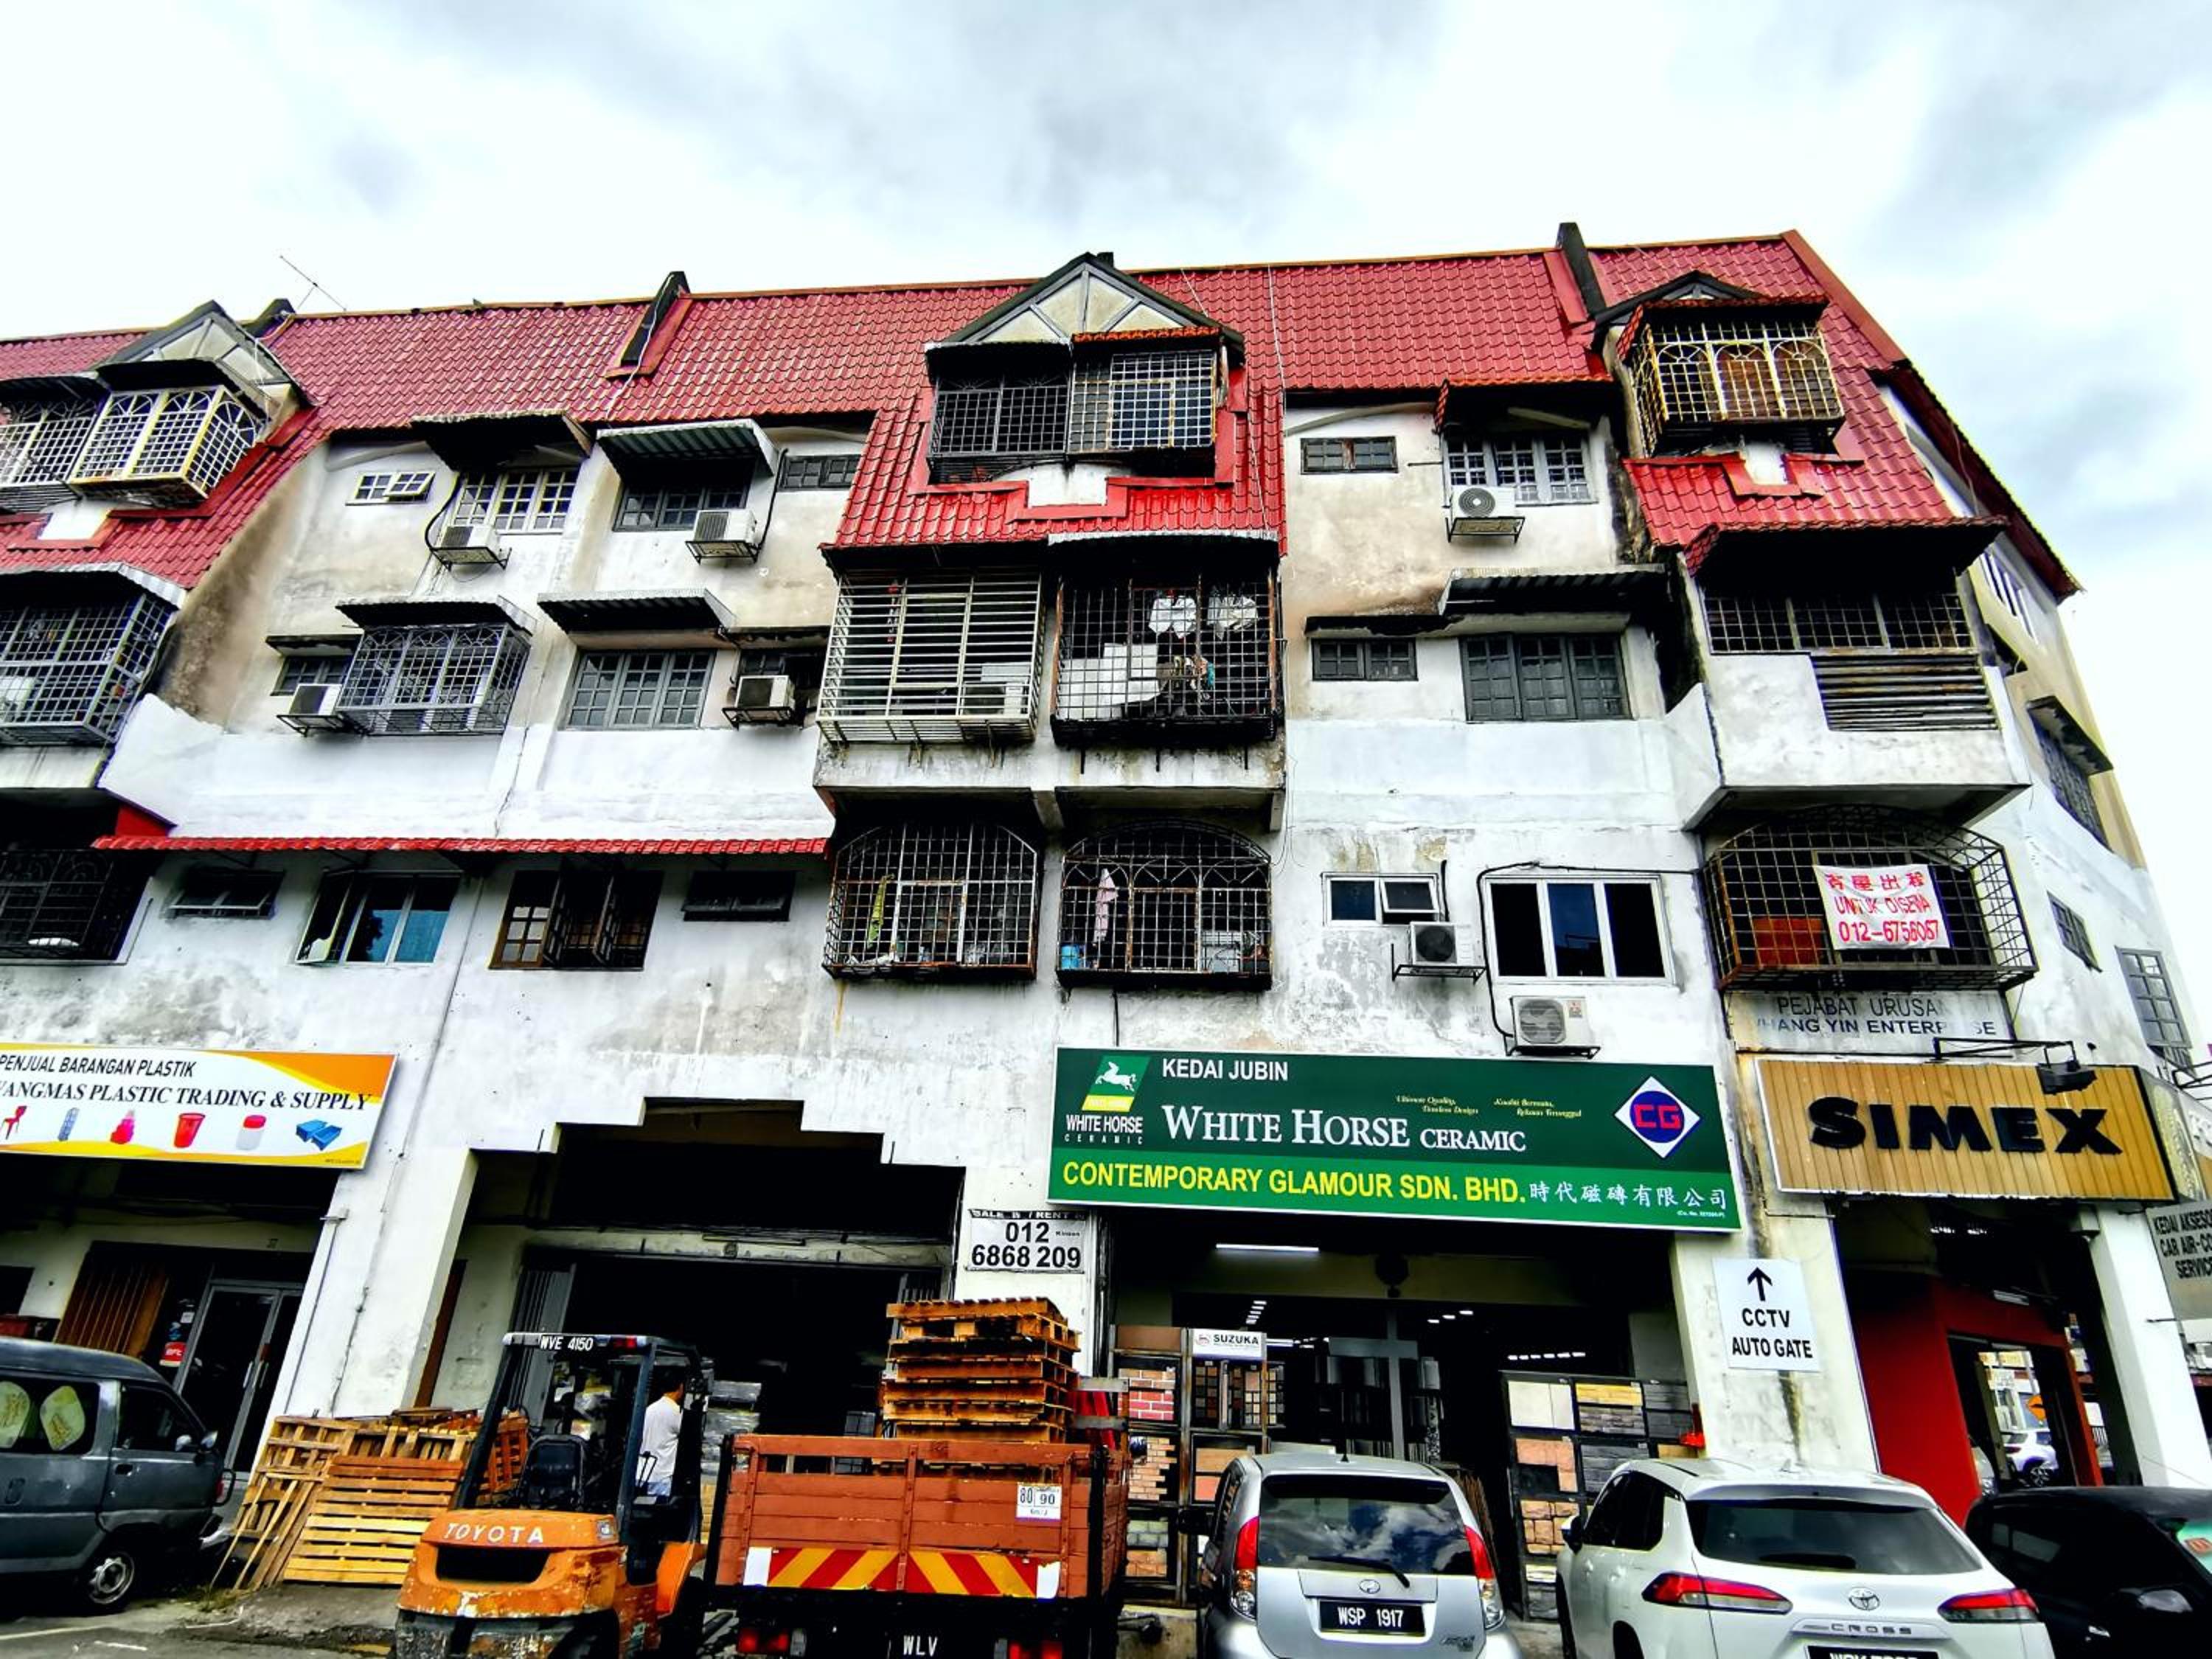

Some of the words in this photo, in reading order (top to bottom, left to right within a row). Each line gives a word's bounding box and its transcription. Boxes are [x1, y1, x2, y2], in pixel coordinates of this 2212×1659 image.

[1884, 894, 1931, 914] DISEWA
[1777, 996, 1858, 1017] PEJABAT
[1825, 1019, 1859, 1033] YIN
[1867, 1020, 1997, 1035] ENTERPSE
[0, 1054, 55, 1072] PENJUAL
[58, 1057, 136, 1075] BARANGAN
[136, 1060, 197, 1077] PLASTIK
[1163, 1058, 1223, 1079] KEDAI
[1229, 1060, 1289, 1081] JUBIN
[88, 1084, 173, 1104] PLASTIC
[176, 1088, 266, 1108] TRADING
[270, 1090, 286, 1108] &
[290, 1092, 372, 1110] SUPPLY
[1065, 1114, 1102, 1132] WHITE
[1103, 1115, 1144, 1133] HORSE
[1632, 1103, 1683, 1130] CG
[1808, 1096, 2124, 1155] SIMEX
[1064, 1133, 1143, 1145] CERAMIC
[1419, 1128, 1527, 1152] CERAMIC
[1062, 1161, 1262, 1192] CONTEMPORARY
[1269, 1169, 1394, 1198] GLAMOUR
[1399, 1173, 1458, 1201] SDN.
[1465, 1175, 1526, 1203] BHD.
[1528, 1180, 1727, 1210] 時代磁磚有限公司
[1006, 1222, 1049, 1243] 012
[972, 1244, 1030, 1267] 6868
[1036, 1245, 1081, 1268] 209
[2160, 1238, 2180, 1258] CAR
[1742, 1307, 1790, 1328] CCTV
[540, 1335, 564, 1350] WVE
[567, 1336, 594, 1352] 4150
[1213, 1334, 1259, 1345] SUZUKA
[1732, 1336, 1771, 1357] AUTO
[1773, 1338, 1814, 1359] GATE
[1020, 1487, 1033, 1504] 80
[1040, 1493, 1056, 1505] 90
[444, 1522, 544, 1544] TOYOTA
[1337, 1606, 1366, 1627] WSP
[1376, 1608, 1404, 1628] 1917
[1831, 1623, 1912, 1635] CROSS
[903, 1634, 938, 1657] WLV
